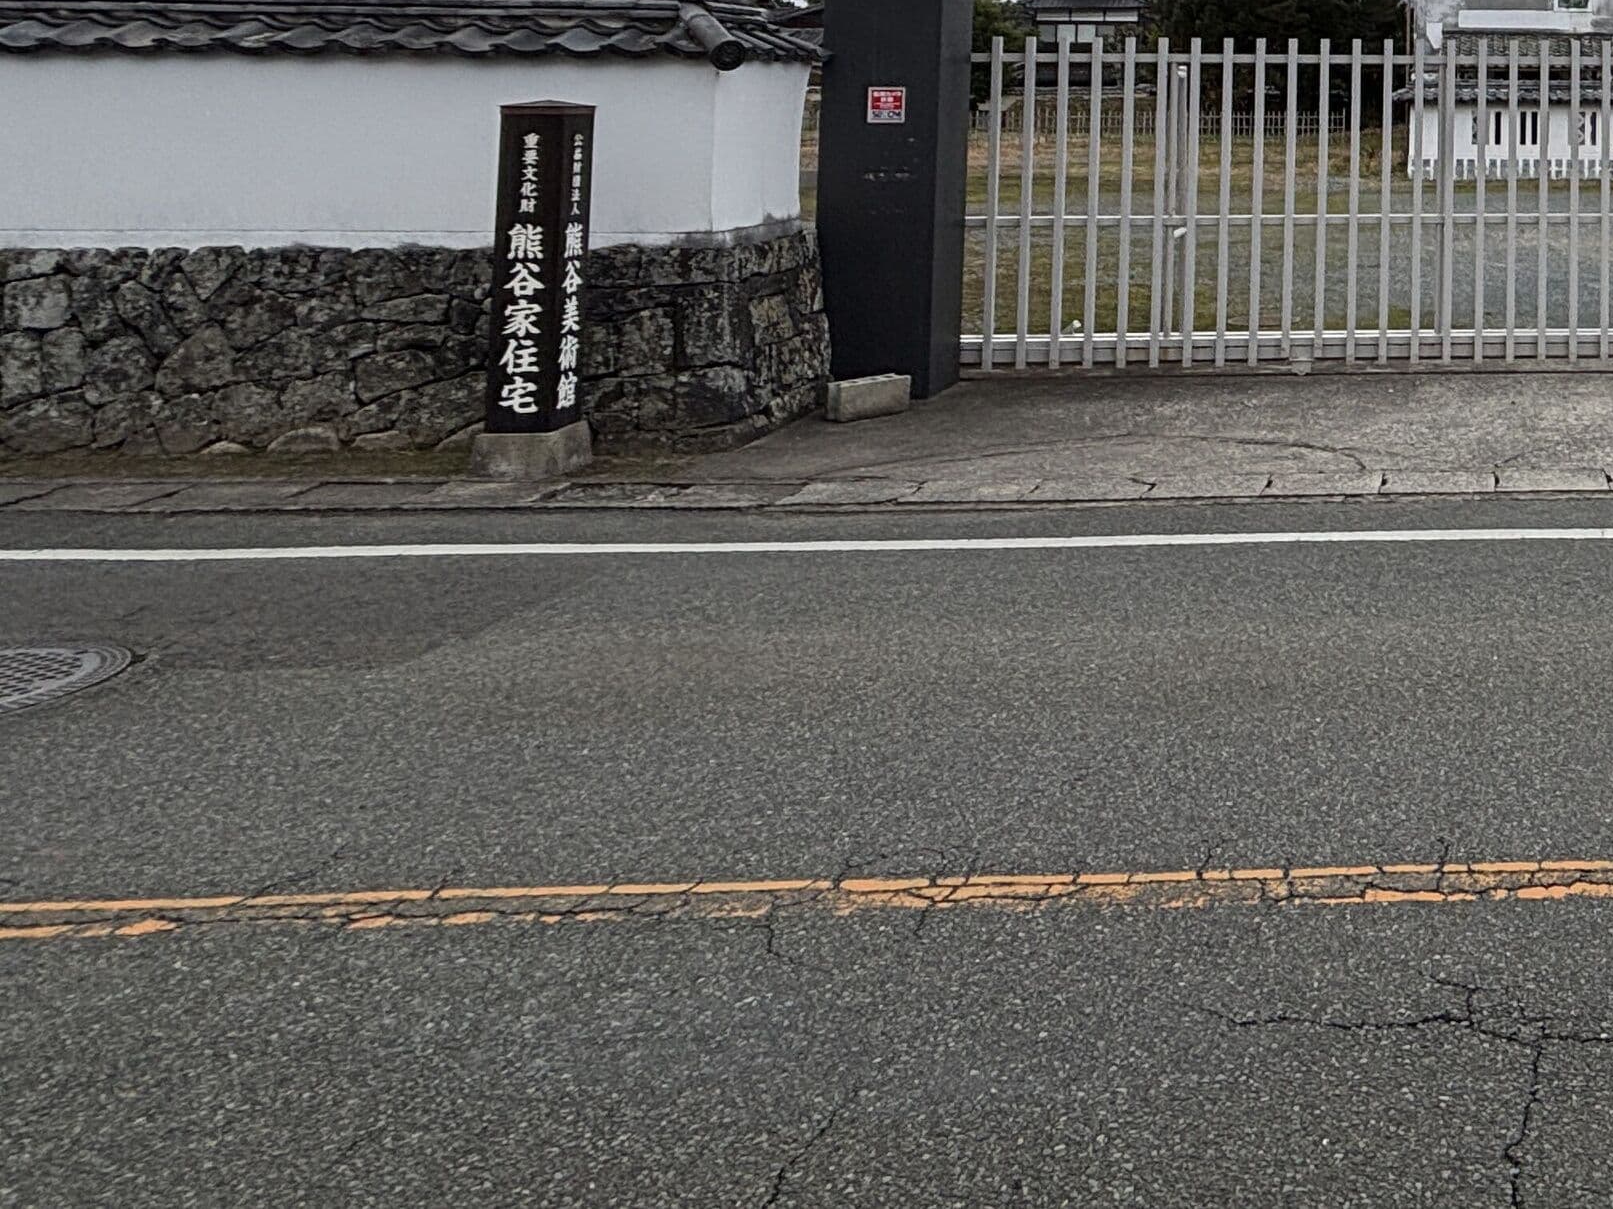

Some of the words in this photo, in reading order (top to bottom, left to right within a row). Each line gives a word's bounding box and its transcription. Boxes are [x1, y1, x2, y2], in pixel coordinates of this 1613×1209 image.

[518, 132, 541, 214] 重要文化財
[498, 222, 545, 414] 熊谷家住宅
[556, 222, 583, 409] 熊谷美術館
